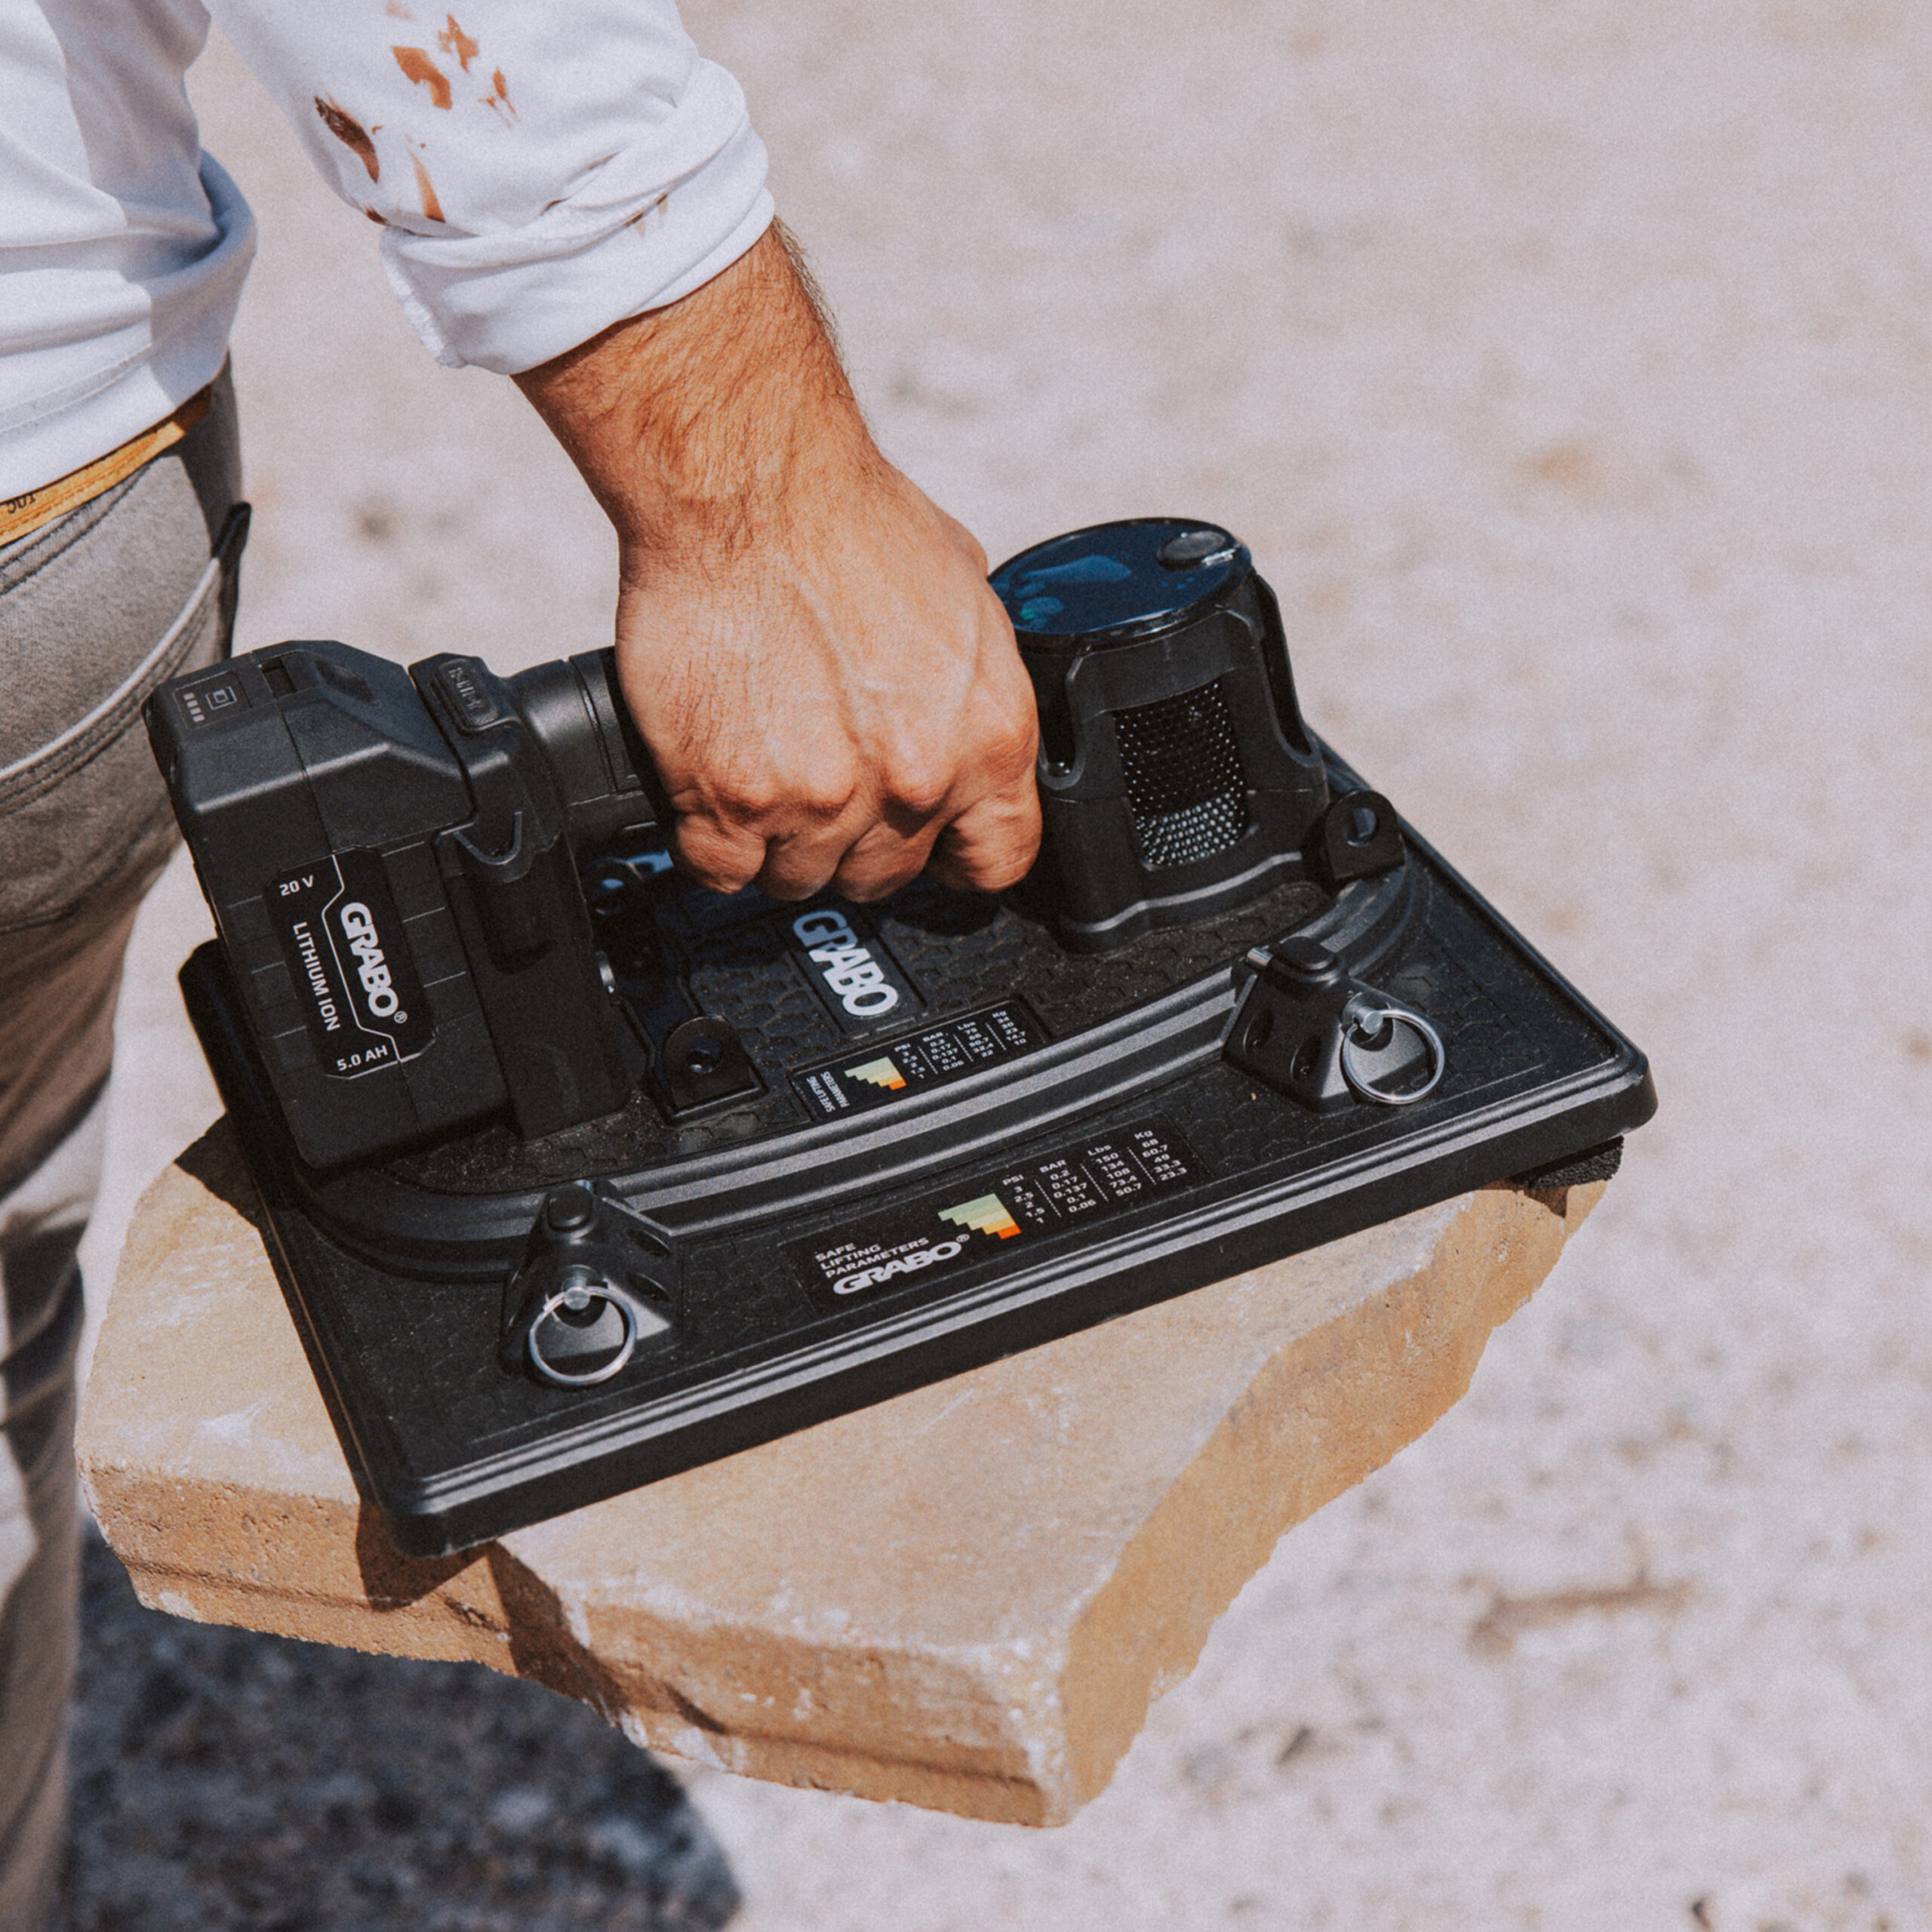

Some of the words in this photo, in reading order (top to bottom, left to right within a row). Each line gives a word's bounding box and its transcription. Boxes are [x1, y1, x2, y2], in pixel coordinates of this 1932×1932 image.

[279, 880, 300, 897] 20
[302, 875, 314, 888] V
[293, 921, 330, 996] LITHIUM
[318, 998, 341, 1031] ION
[792, 910, 899, 1017] GRABO
[903, 1055, 918, 1064] 2.5
[931, 1043, 951, 1054] 0.17
[930, 1038, 945, 1048] 0.2
[337, 1054, 361, 1072] 5.0
[365, 1044, 388, 1063] AH
[910, 1066, 925, 1075] 1.5
[941, 1056, 956, 1064] 0.1
[806, 1076, 826, 1099] LIFTING
[1002, 1174, 1024, 1186] PSI
[1088, 1145, 1112, 1156] Lbs
[1134, 1130, 1153, 1140] Kg
[1050, 1170, 1070, 1180] 0.2
[1096, 1152, 1119, 1164] 150
[1142, 1139, 1158, 1148] 68
[1014, 1192, 1034, 1203] 2.5
[1051, 1176, 1078, 1189] 0.17
[1101, 1160, 1124, 1172] 134
[1142, 1144, 1168, 1158] 60.7
[1053, 1182, 1087, 1198] 0.137
[1106, 1168, 1131, 1179] 108
[1154, 1154, 1170, 1163] 49
[1115, 1183, 1142, 1196] 50.7
[1160, 1168, 1187, 1181] 23.3
[1026, 1208, 1045, 1217] 1.5
[1066, 1193, 1086, 1204] 0.1
[1109, 1175, 1137, 1188] 73.4
[1154, 1159, 1181, 1173] 33.3
[815, 1243, 856, 1262] SAFE
[820, 1244, 881, 1270] LIFTING
[825, 1237, 929, 1278] PARAMETERS
